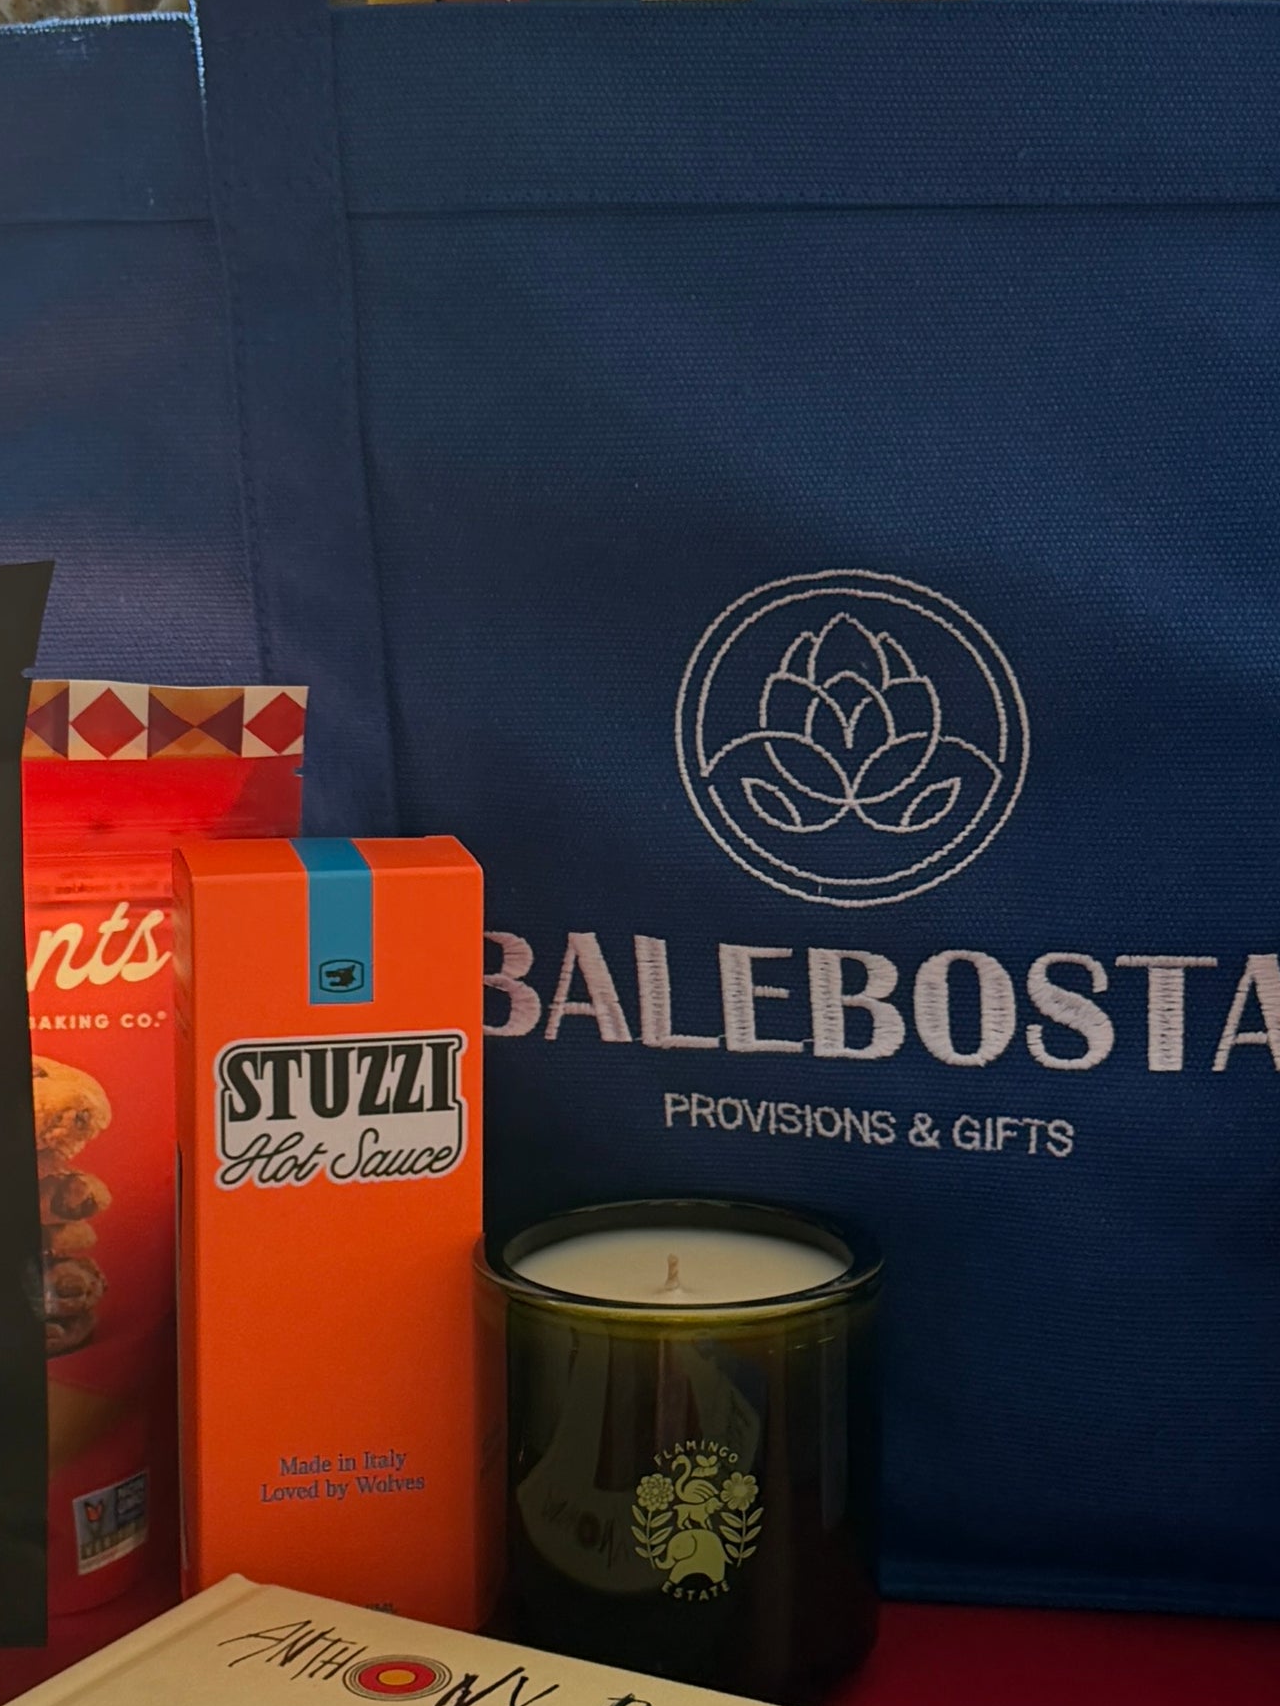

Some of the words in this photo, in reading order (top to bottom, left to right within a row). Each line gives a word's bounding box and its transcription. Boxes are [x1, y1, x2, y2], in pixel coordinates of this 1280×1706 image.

[226, 1042, 456, 1122] STUZZI
[664, 1093, 896, 1144] PROVISIONS
[908, 1113, 941, 1149] &
[952, 1115, 1074, 1157] GIFTS
[220, 1131, 328, 1185] Hot
[331, 1127, 455, 1179] Sauce
[280, 1455, 332, 1476] Made
[338, 1453, 357, 1472] in
[363, 1449, 406, 1470] Italy
[653, 1439, 740, 1466] FLAMINGO
[261, 1480, 319, 1503] Loved
[325, 1479, 349, 1500] by
[355, 1474, 425, 1494] Wolves
[661, 1580, 730, 1601] ESTATE
